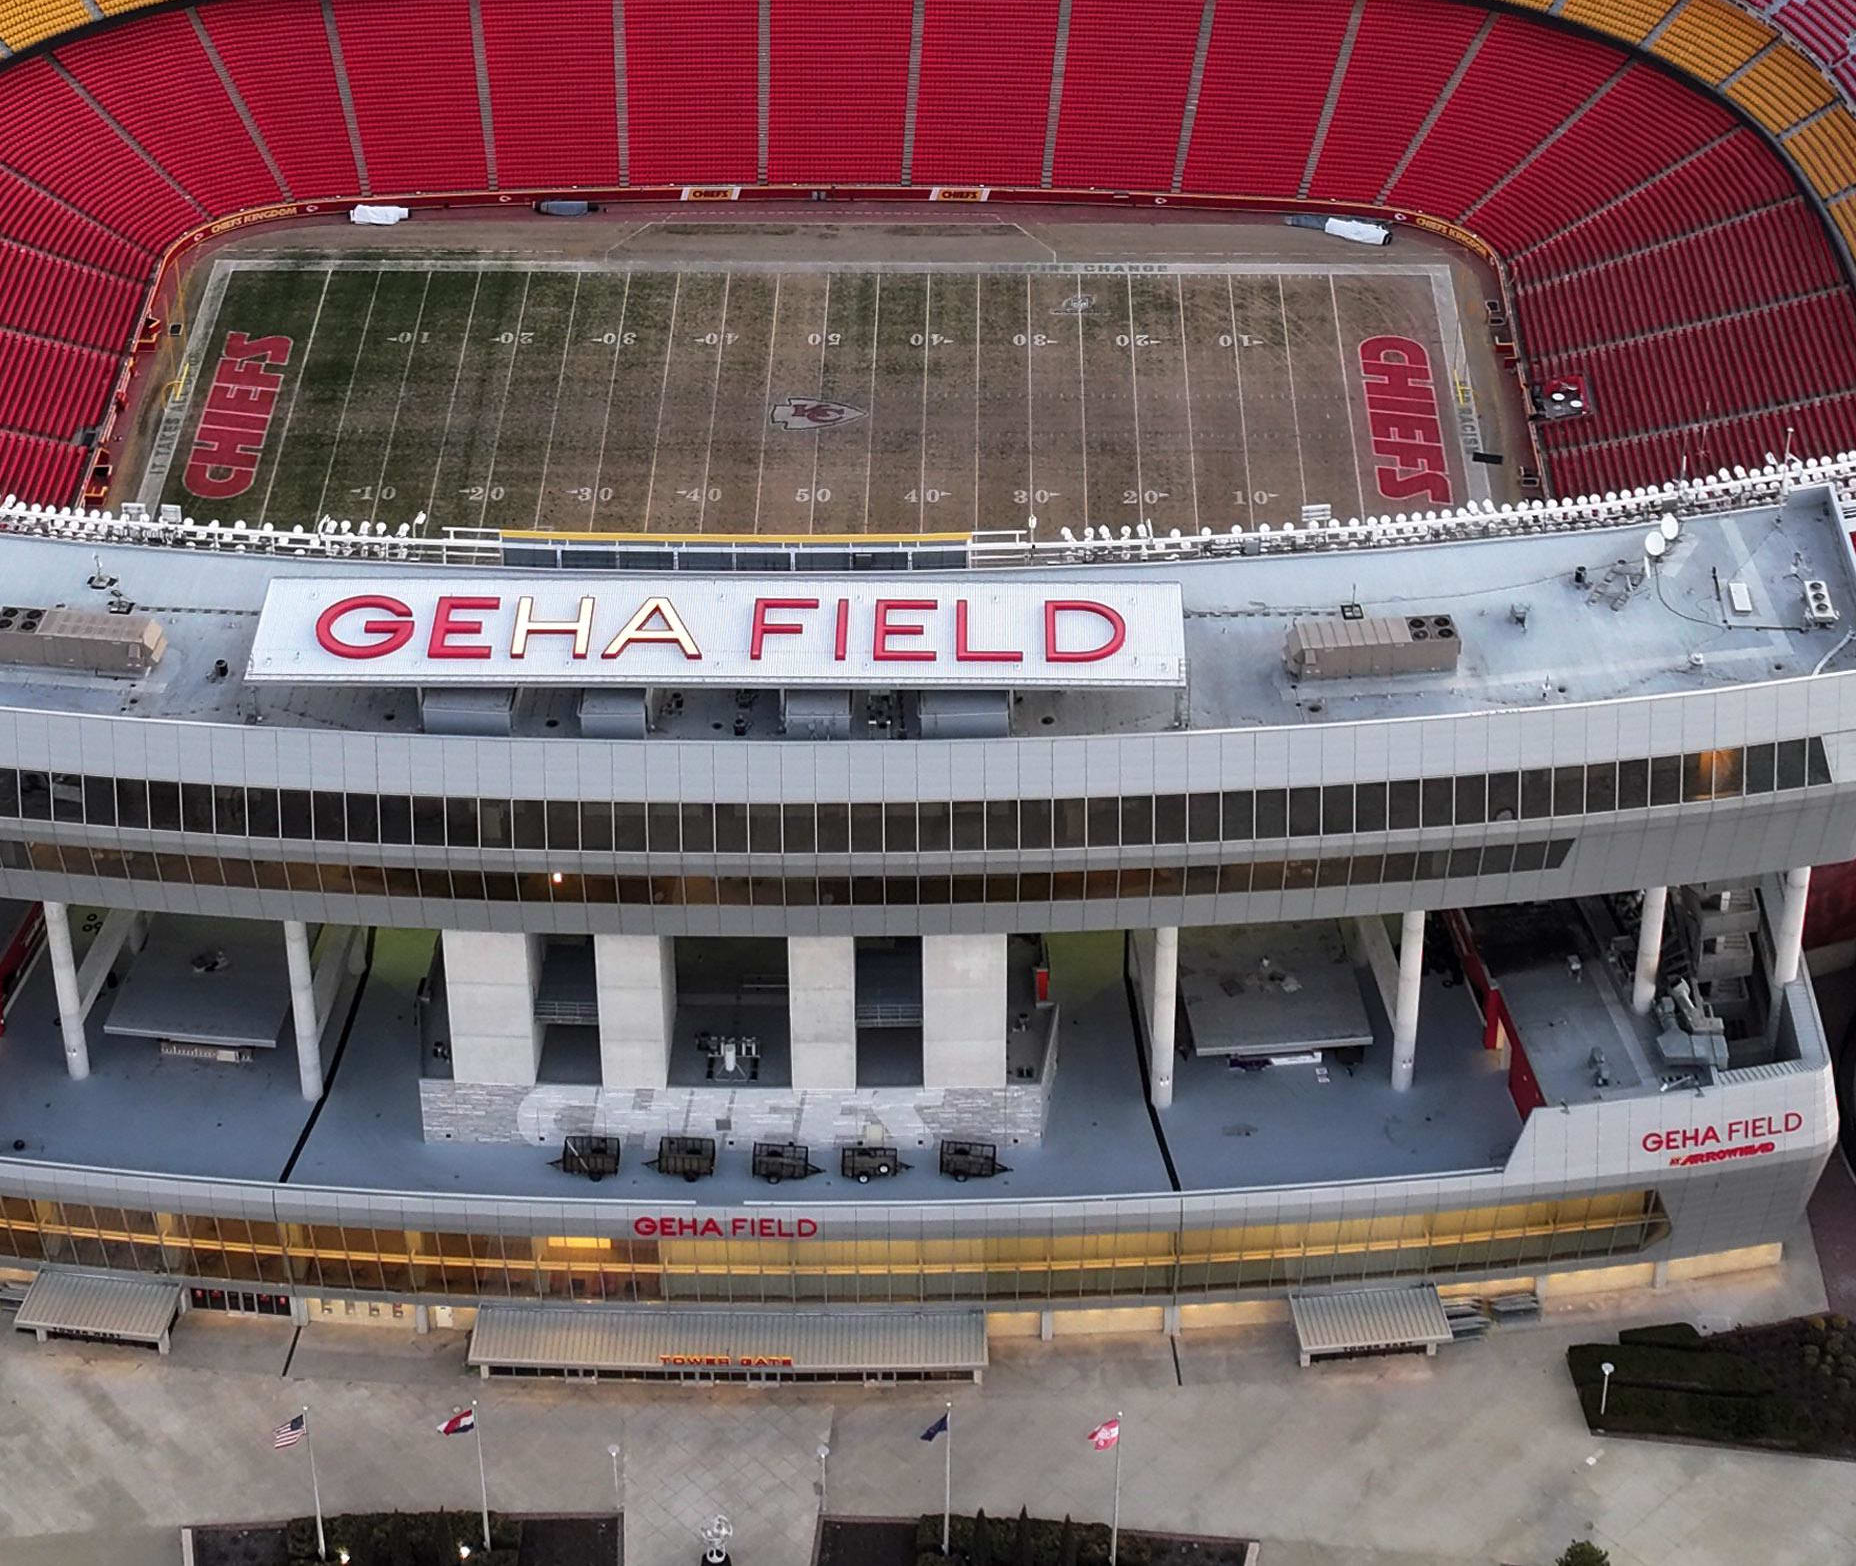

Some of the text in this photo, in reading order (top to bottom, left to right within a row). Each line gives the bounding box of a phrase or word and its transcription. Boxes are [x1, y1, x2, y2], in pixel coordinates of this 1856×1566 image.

[692, 189, 729, 199] CHIEFS
[941, 191, 978, 200] CHIEFS
[211, 207, 297, 233] CHIEFS KINGDOM
[1415, 216, 1448, 234] CHIEFS
[1084, 264, 1168, 273] CHANGE
[182, 330, 294, 500] CHIEFS
[1358, 334, 1454, 506] CHIEFS
[155, 417, 179, 456] TAKES
[360, 486, 396, 501] 10
[468, 486, 505, 501] 20
[577, 487, 614, 502] 30
[685, 487, 722, 502] 40
[795, 488, 831, 503] 50
[904, 488, 940, 503] 40
[1013, 489, 1050, 504] 30
[1123, 489, 1159, 504] 20
[1232, 490, 1268, 505] 10
[314, 593, 1127, 663] GEHA FIELD
[1642, 1112, 1803, 1153] GEHA FIELD
[1679, 1141, 1776, 1167] ARROWHEAD
[634, 1216, 817, 1238] GEHA FIELD
[660, 1355, 793, 1367] TOWER GATE
